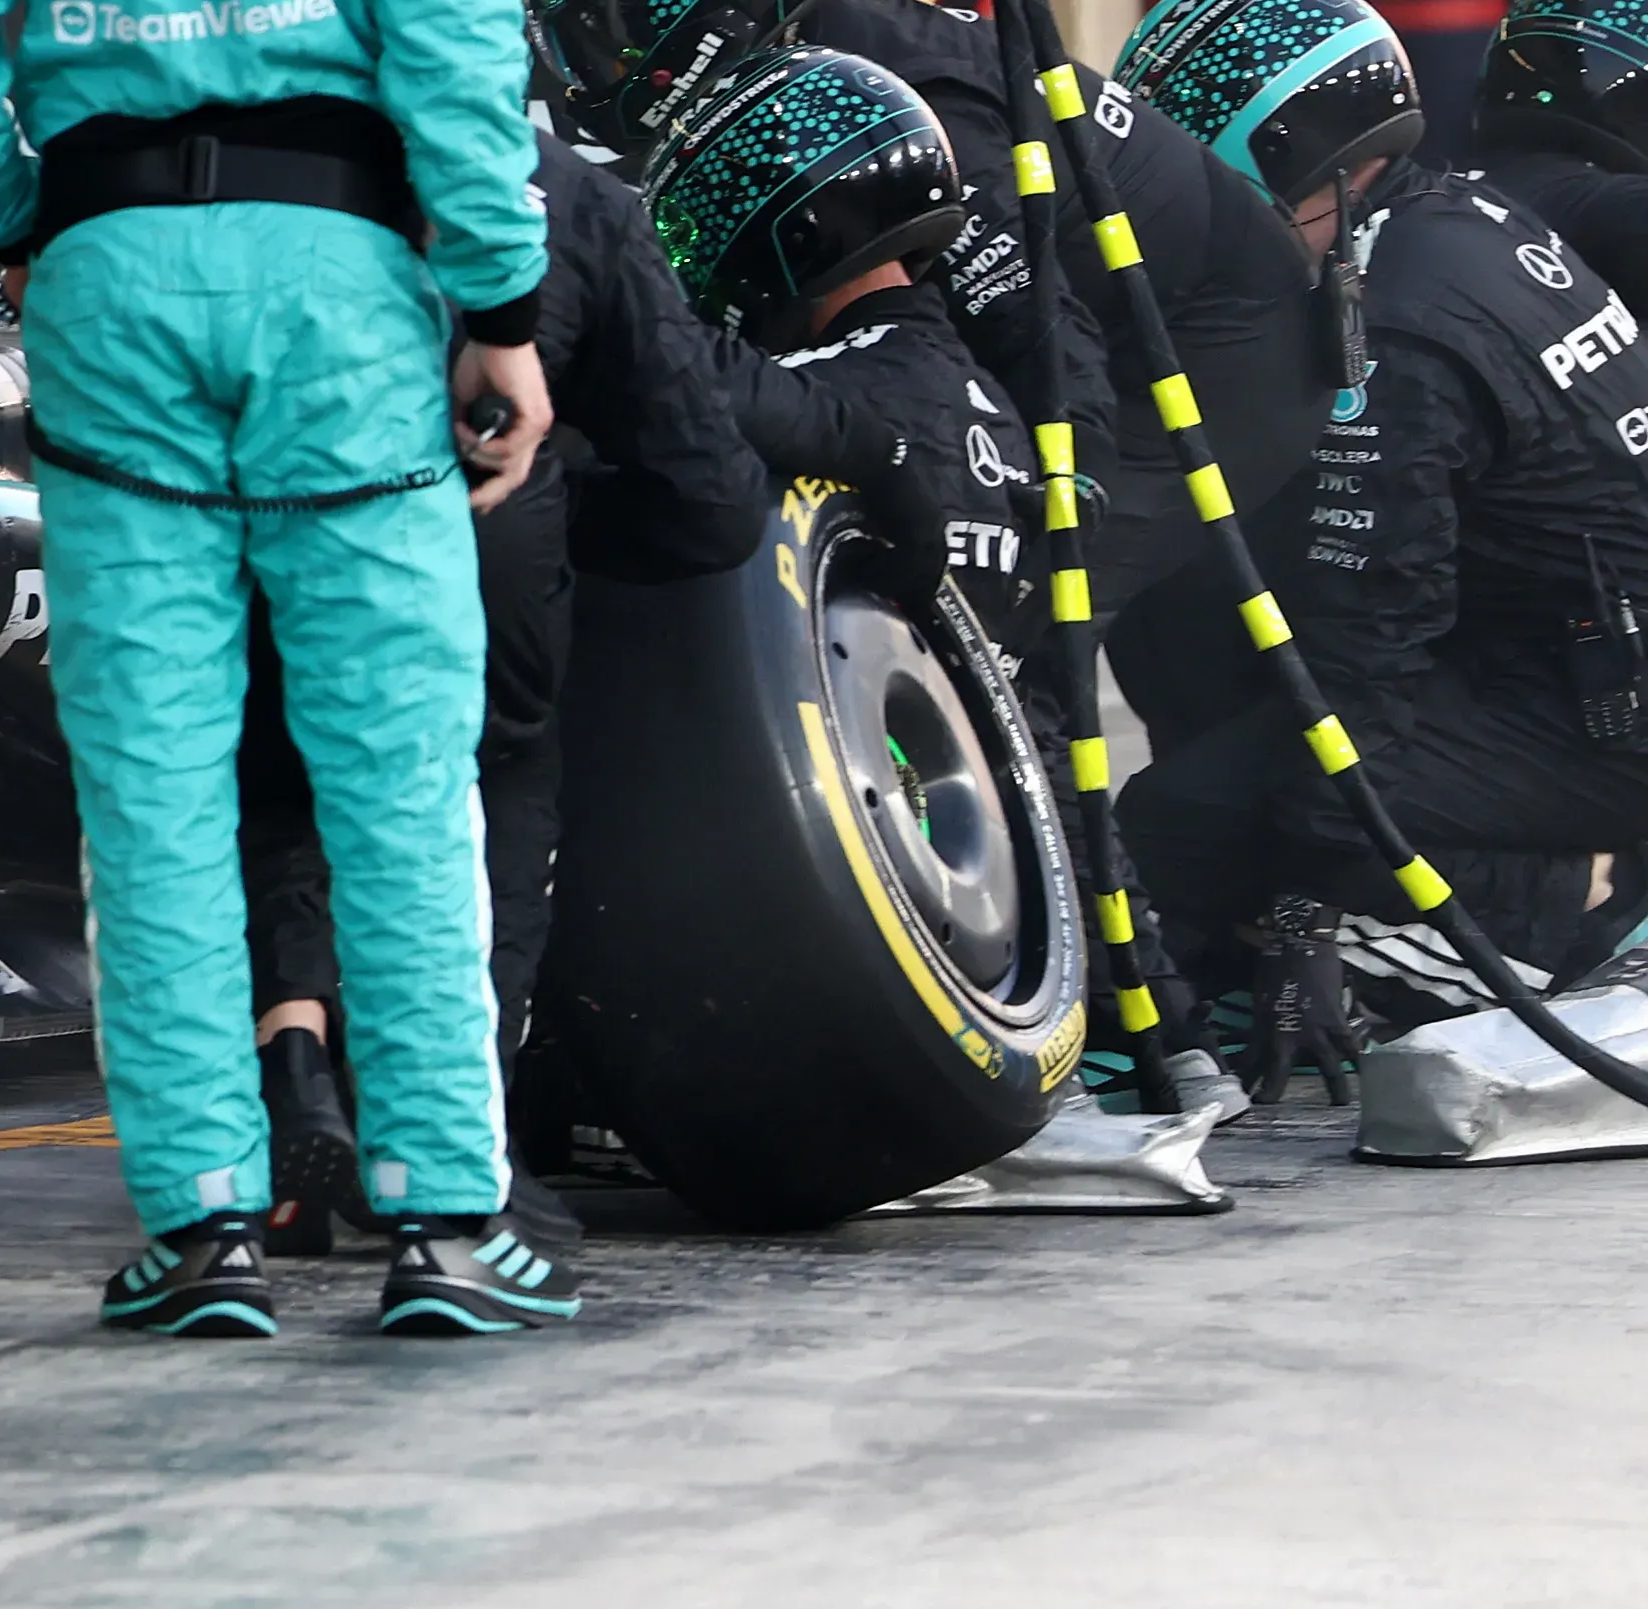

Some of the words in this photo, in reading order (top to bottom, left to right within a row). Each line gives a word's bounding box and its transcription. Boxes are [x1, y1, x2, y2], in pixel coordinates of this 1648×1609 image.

[639, 31, 724, 130] Einhell
[941, 214, 989, 267] IWC
[775, 542, 807, 610] P
